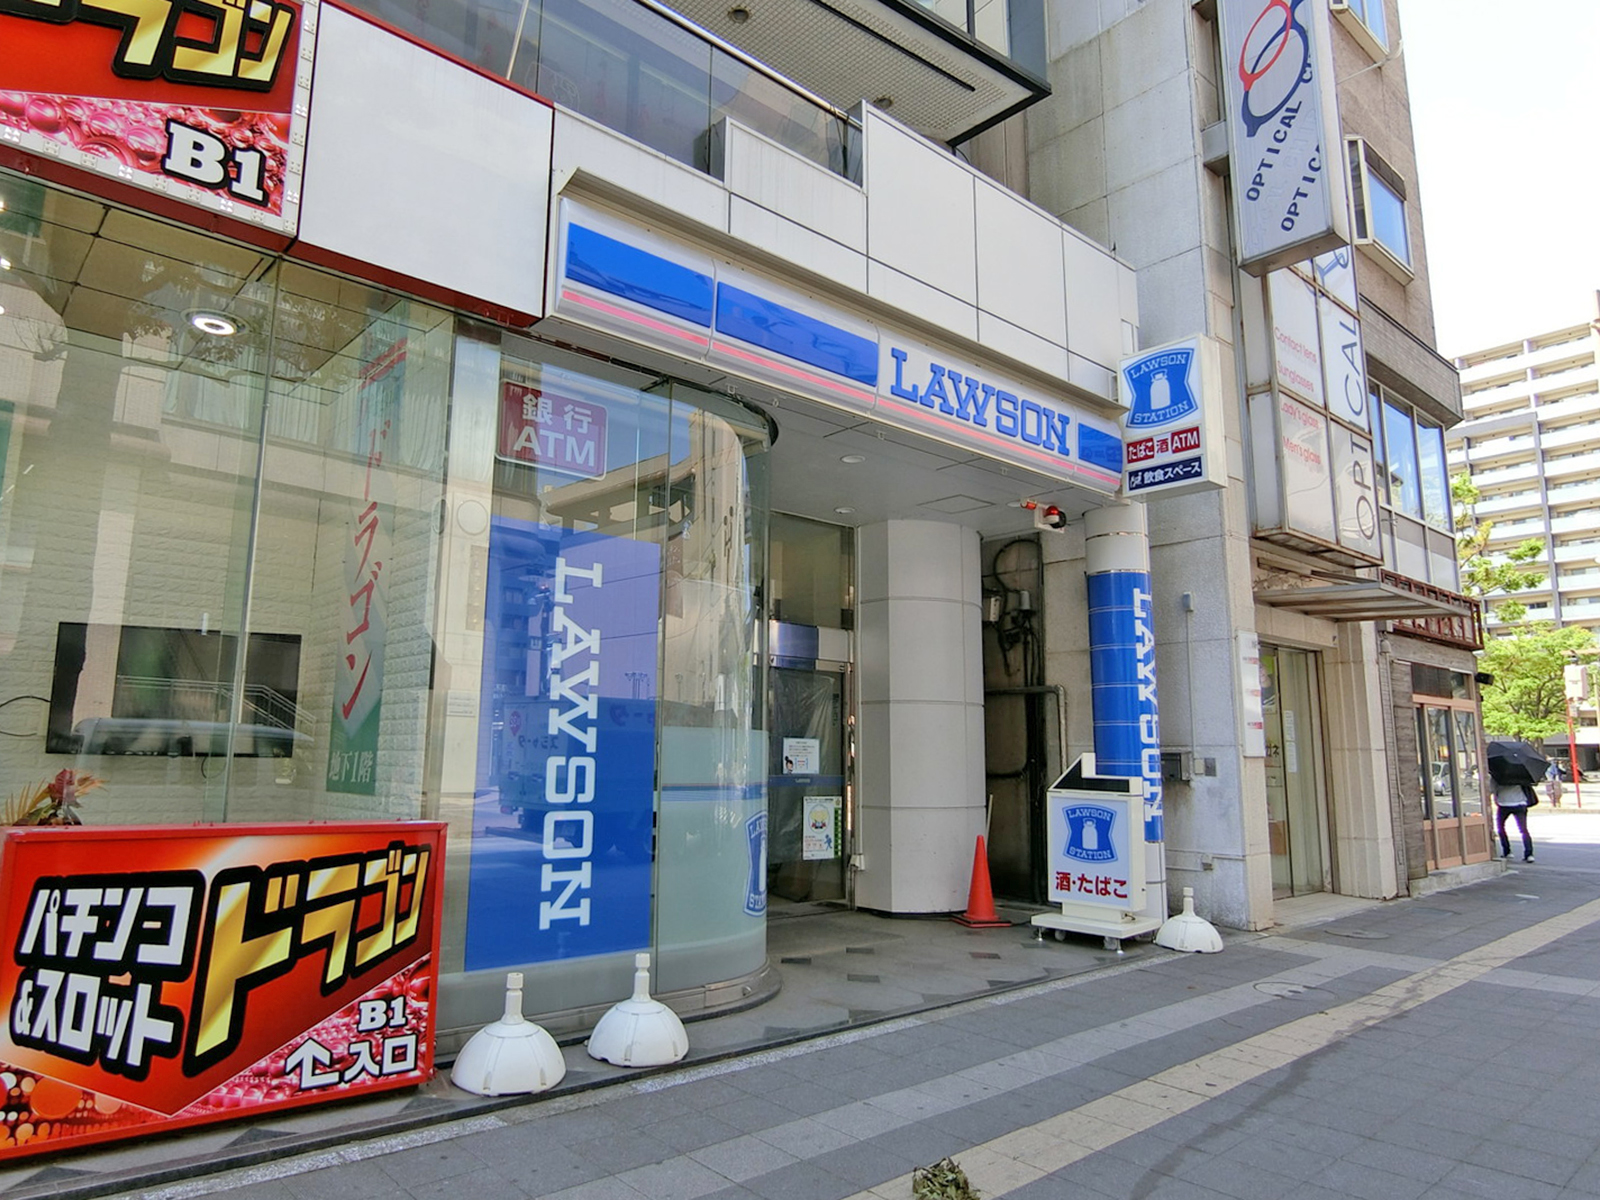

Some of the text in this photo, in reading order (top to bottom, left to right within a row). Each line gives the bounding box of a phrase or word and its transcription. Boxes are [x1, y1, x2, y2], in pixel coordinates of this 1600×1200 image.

[0, 0, 292, 82] ラゴン
[165, 120, 265, 201] B1
[1246, 100, 1302, 201] OPTICAL
[1280, 145, 1321, 231] OPTIC
[1131, 353, 1188, 379] LAWSON
[522, 393, 593, 434] 銀行
[890, 347, 1070, 456] LAWSON
[1134, 401, 1190, 423] STATION
[513, 425, 595, 467] ATM
[1128, 442, 1154, 460] たばこ
[1172, 430, 1199, 450] ATM
[1144, 461, 1201, 484] 飲食スペース
[539, 556, 603, 930] LAWSON
[329, 750, 374, 783] 地下1階
[1068, 808, 1112, 822] LAWSON
[1069, 846, 1112, 860] STATION
[20, 885, 195, 966] パチンコ
[195, 849, 430, 1057] ドラゴン
[14, 968, 175, 1067] &スロット
[358, 996, 408, 1032] B1
[343, 1033, 419, 1082] 入口
